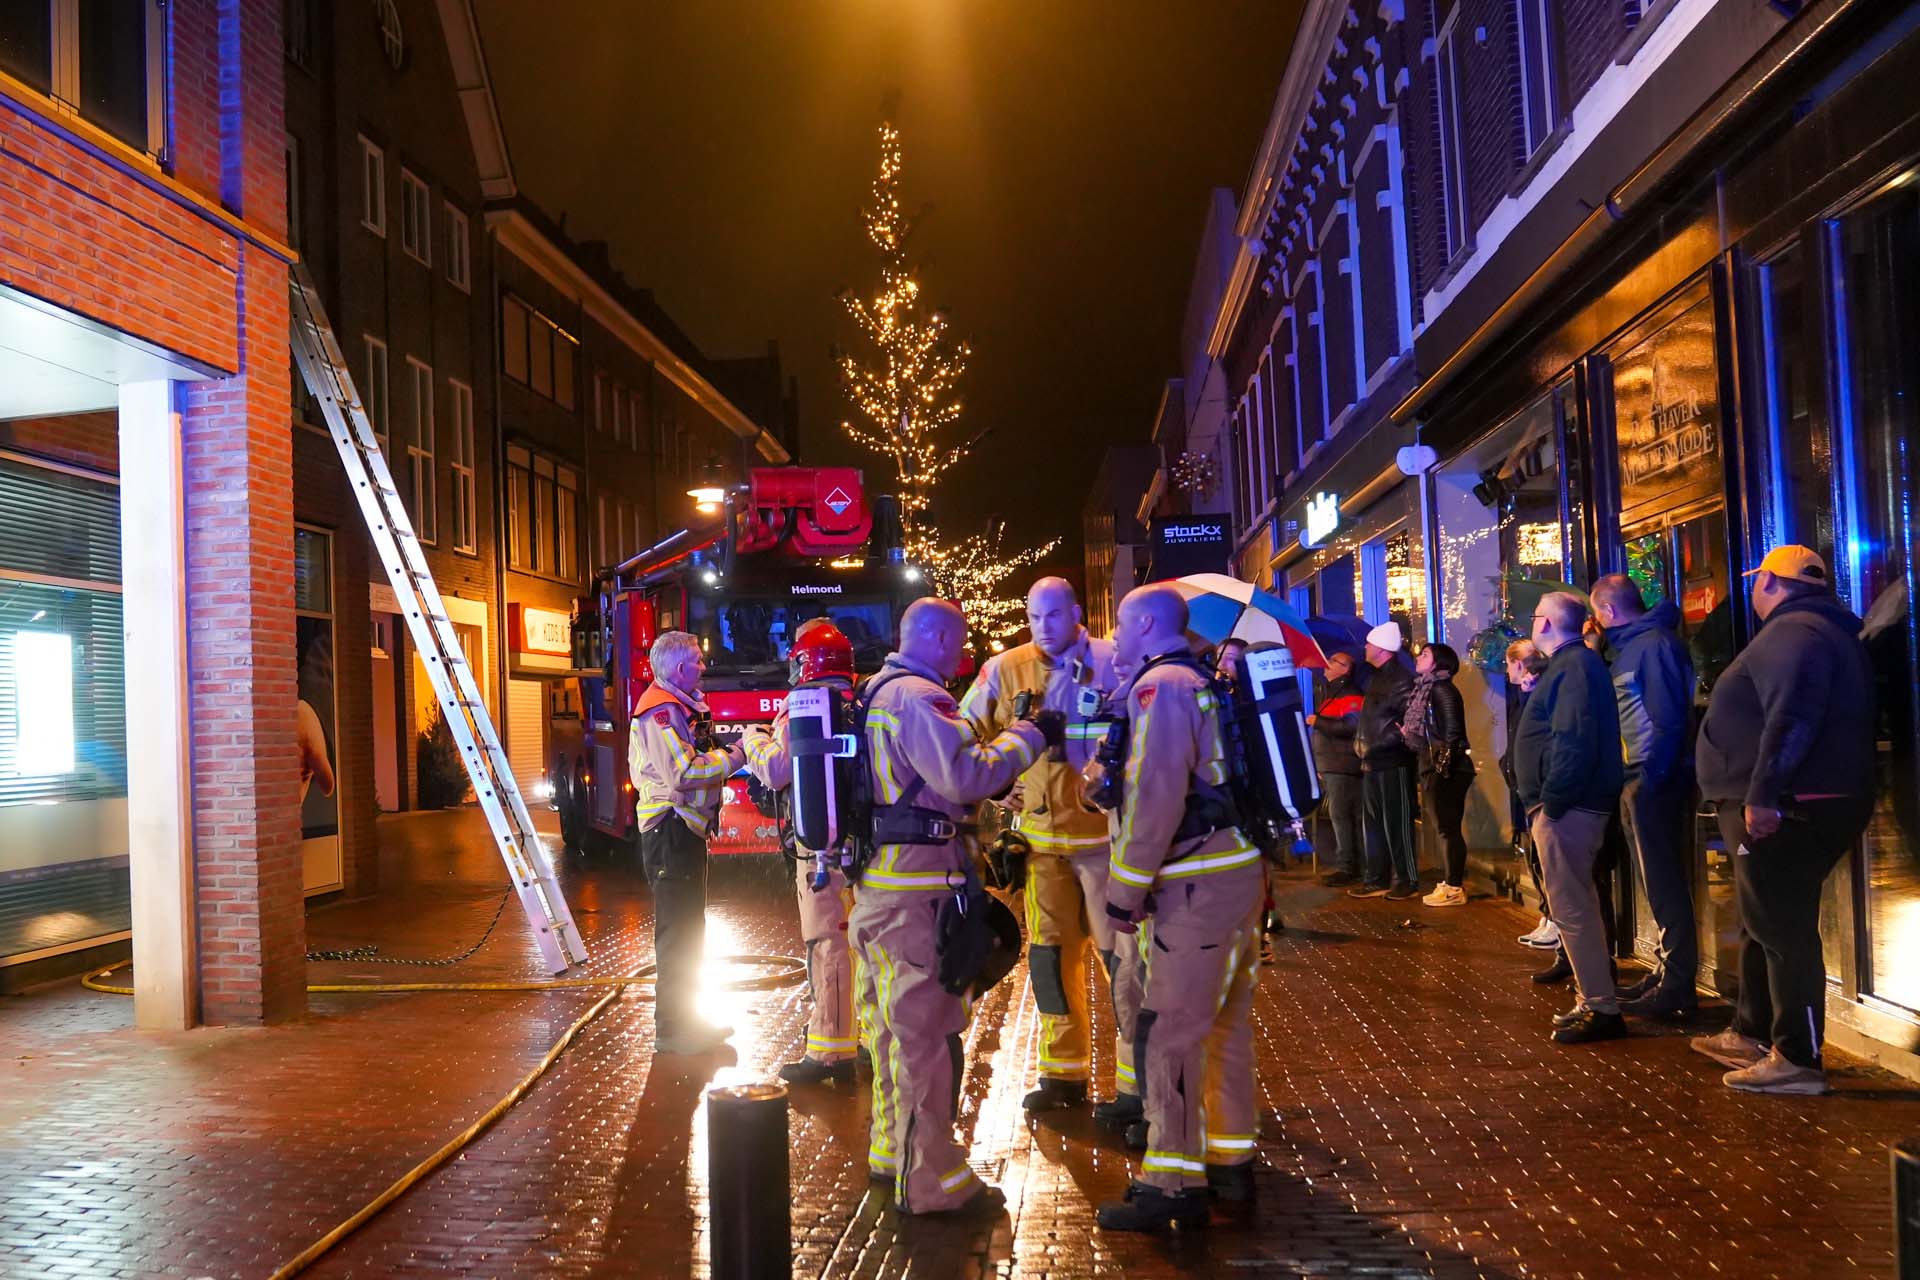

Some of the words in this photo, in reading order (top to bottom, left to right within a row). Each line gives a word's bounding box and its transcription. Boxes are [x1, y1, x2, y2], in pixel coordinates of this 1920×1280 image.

[1658, 390, 1701, 434] HAVER
[1623, 423, 1714, 486] MENMODE
[791, 584, 842, 594] Helmond
